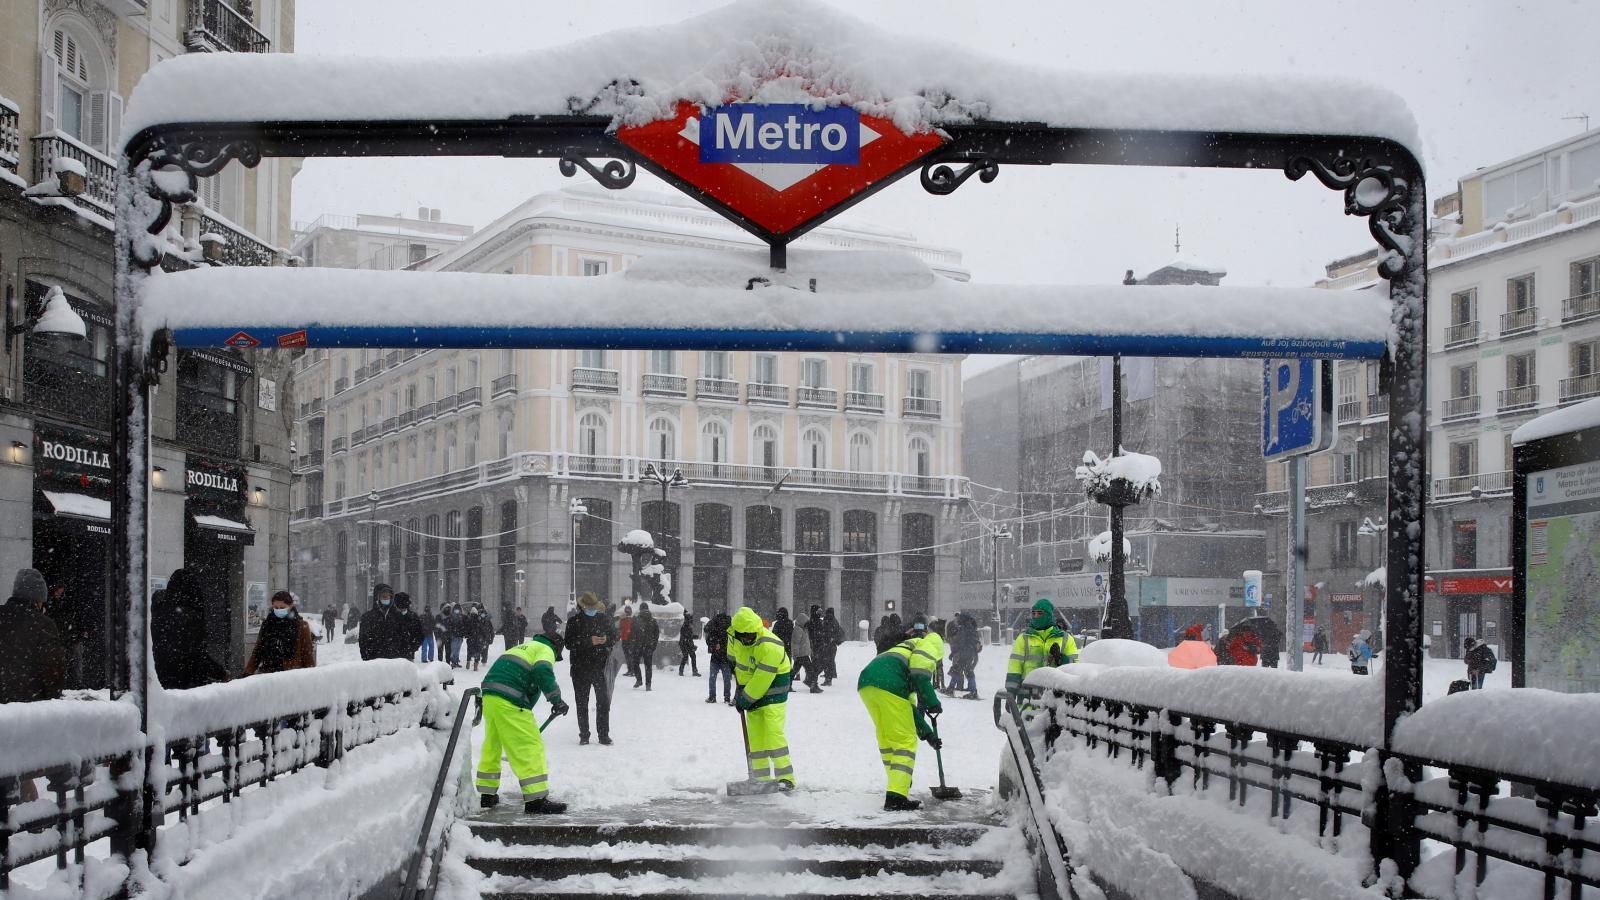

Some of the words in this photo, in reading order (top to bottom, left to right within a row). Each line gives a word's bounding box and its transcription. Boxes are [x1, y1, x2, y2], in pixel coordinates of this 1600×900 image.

[716, 113, 848, 151] Metro
[1278, 340, 1289, 348] for
[1291, 340, 1331, 349] apologize
[1301, 350, 1344, 358] Disculpen
[192, 350, 231, 368] HAMBURGUESA
[232, 363, 253, 374] NOSTRA
[1270, 358, 1300, 444] P
[42, 441, 111, 469] RODILLA
[187, 469, 239, 492] RODILLA
[1555, 471, 1576, 480] Plano
[1558, 479, 1579, 489] Metro
[87, 525, 112, 535] RODILLA
[1332, 593, 1362, 602] SOUVENIRS
